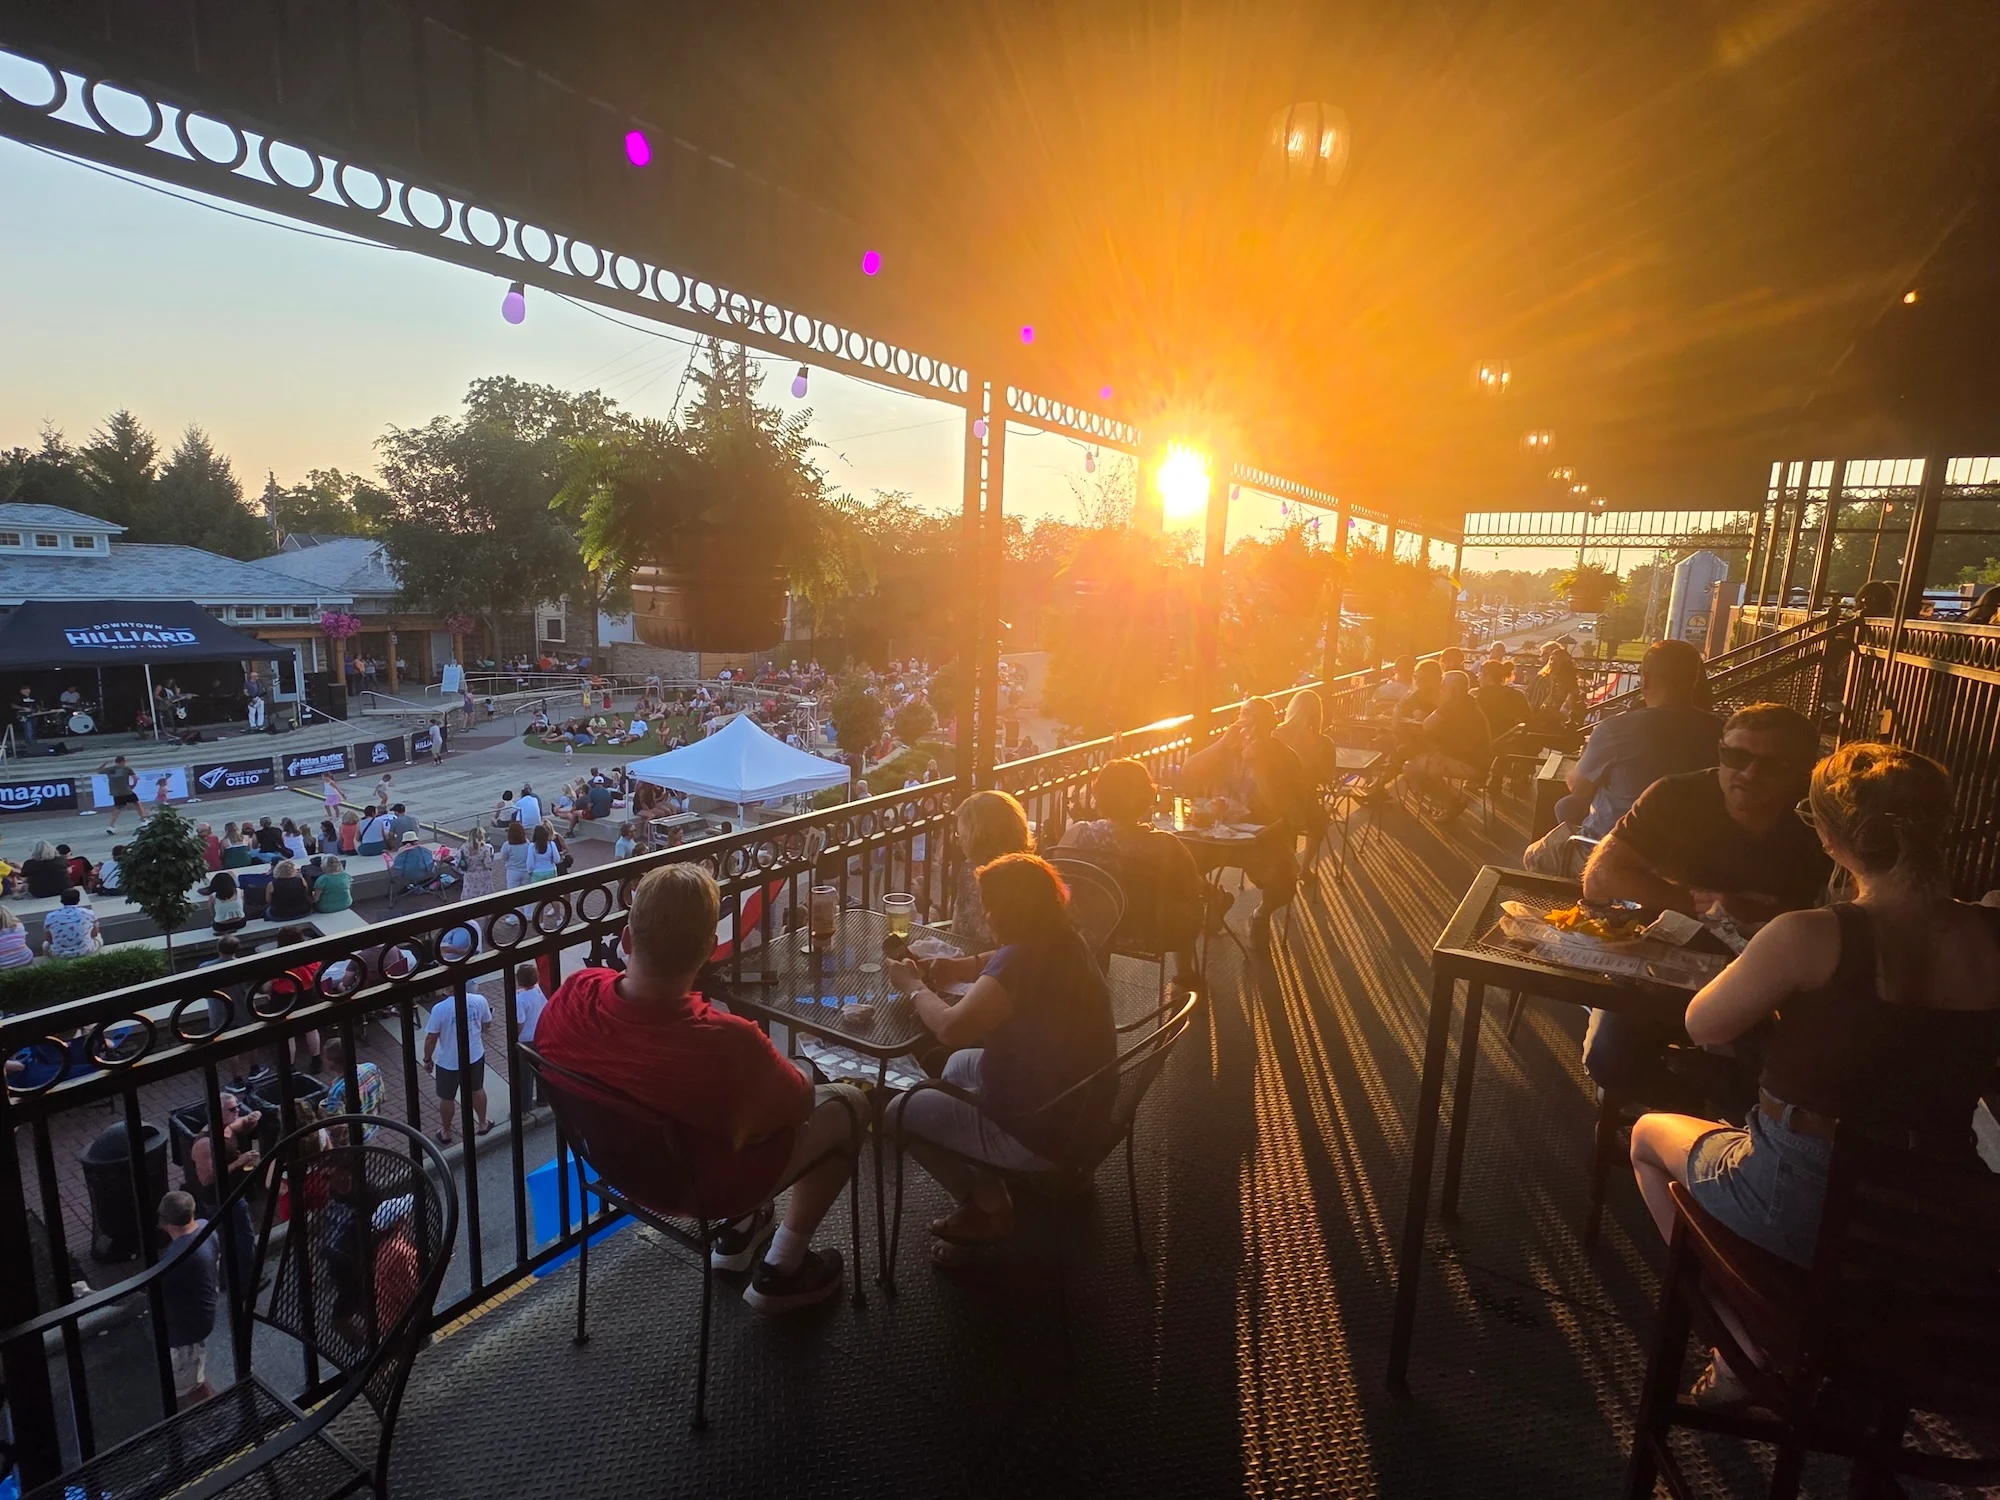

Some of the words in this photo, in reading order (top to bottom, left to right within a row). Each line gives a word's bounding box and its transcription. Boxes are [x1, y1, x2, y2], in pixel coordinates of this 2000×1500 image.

[93, 622, 162, 631] DOWNTOWN
[65, 630, 197, 645] HILLIARD
[226, 775, 260, 787] OHIO
